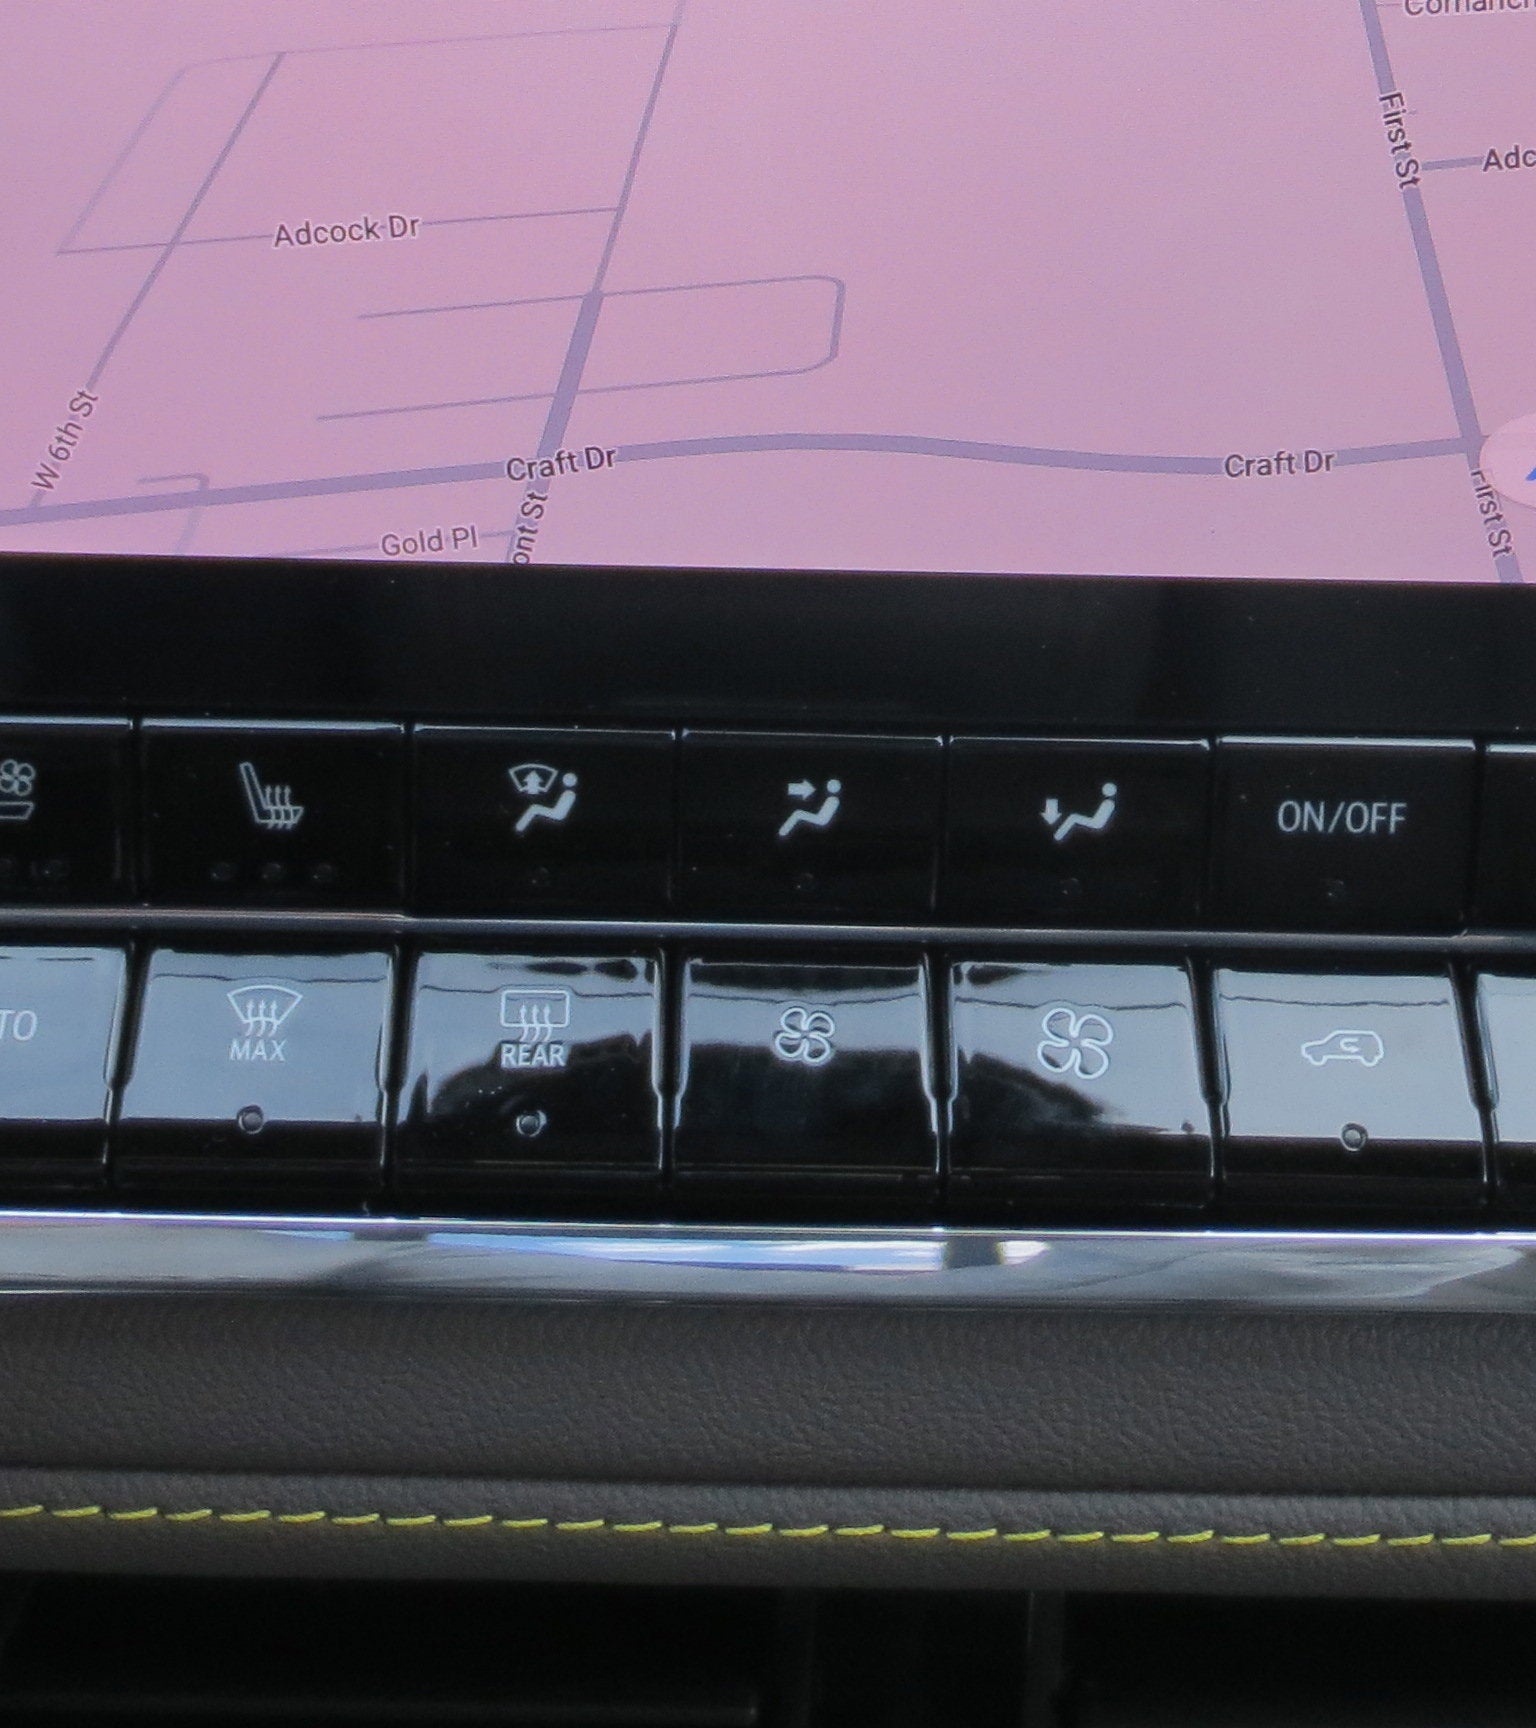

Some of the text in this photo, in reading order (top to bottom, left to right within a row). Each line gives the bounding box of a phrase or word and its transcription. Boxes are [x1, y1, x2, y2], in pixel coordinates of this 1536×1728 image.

[1378, 90, 1421, 190] First St
[272, 214, 420, 248] Adcock Dr
[31, 388, 100, 494] W 6th St
[505, 446, 616, 482] Craft Dr
[1224, 448, 1335, 478] Craft Dr
[520, 491, 549, 520] St
[380, 525, 478, 557] Gold Pl
[1488, 529, 1513, 558] St
[1277, 801, 1408, 835] ON/OFF
[228, 1038, 287, 1063] MAX
[500, 1042, 568, 1068] REAR
